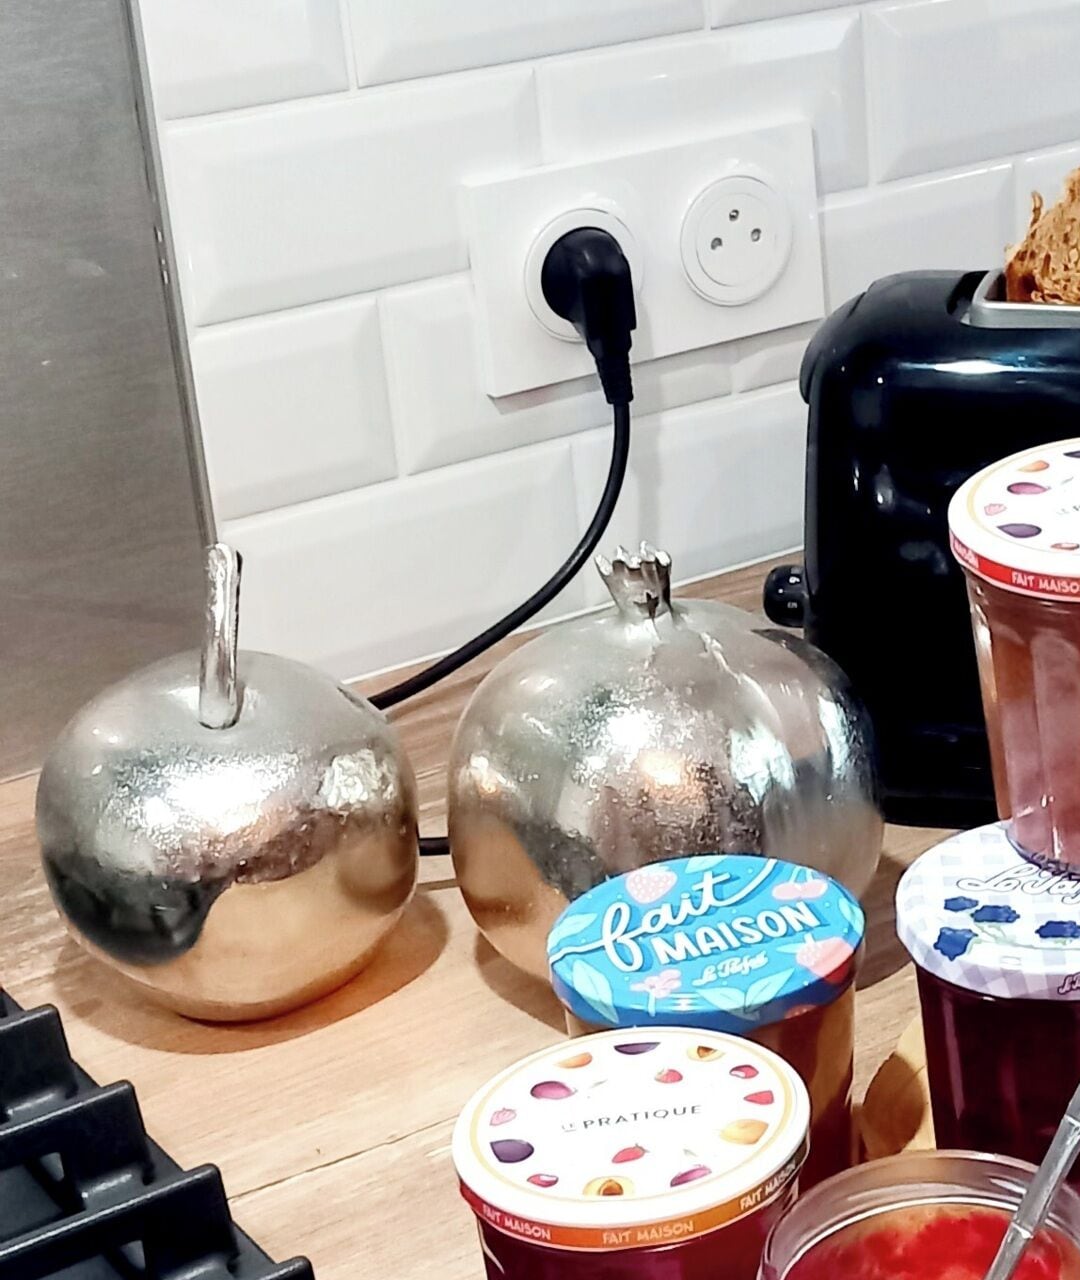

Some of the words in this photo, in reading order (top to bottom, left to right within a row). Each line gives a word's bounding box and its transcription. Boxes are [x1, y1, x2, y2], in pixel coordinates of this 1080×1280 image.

[1011, 570, 1035, 588] FAIT
[602, 857, 778, 973] fait
[651, 900, 822, 966] MAISON
[582, 1104, 701, 1129] PRATIQUE
[741, 1187, 763, 1211] FAIT
[504, 1216, 552, 1241] MAISON
[602, 1230, 632, 1245] FAIT
[636, 1220, 695, 1241] MAISON
